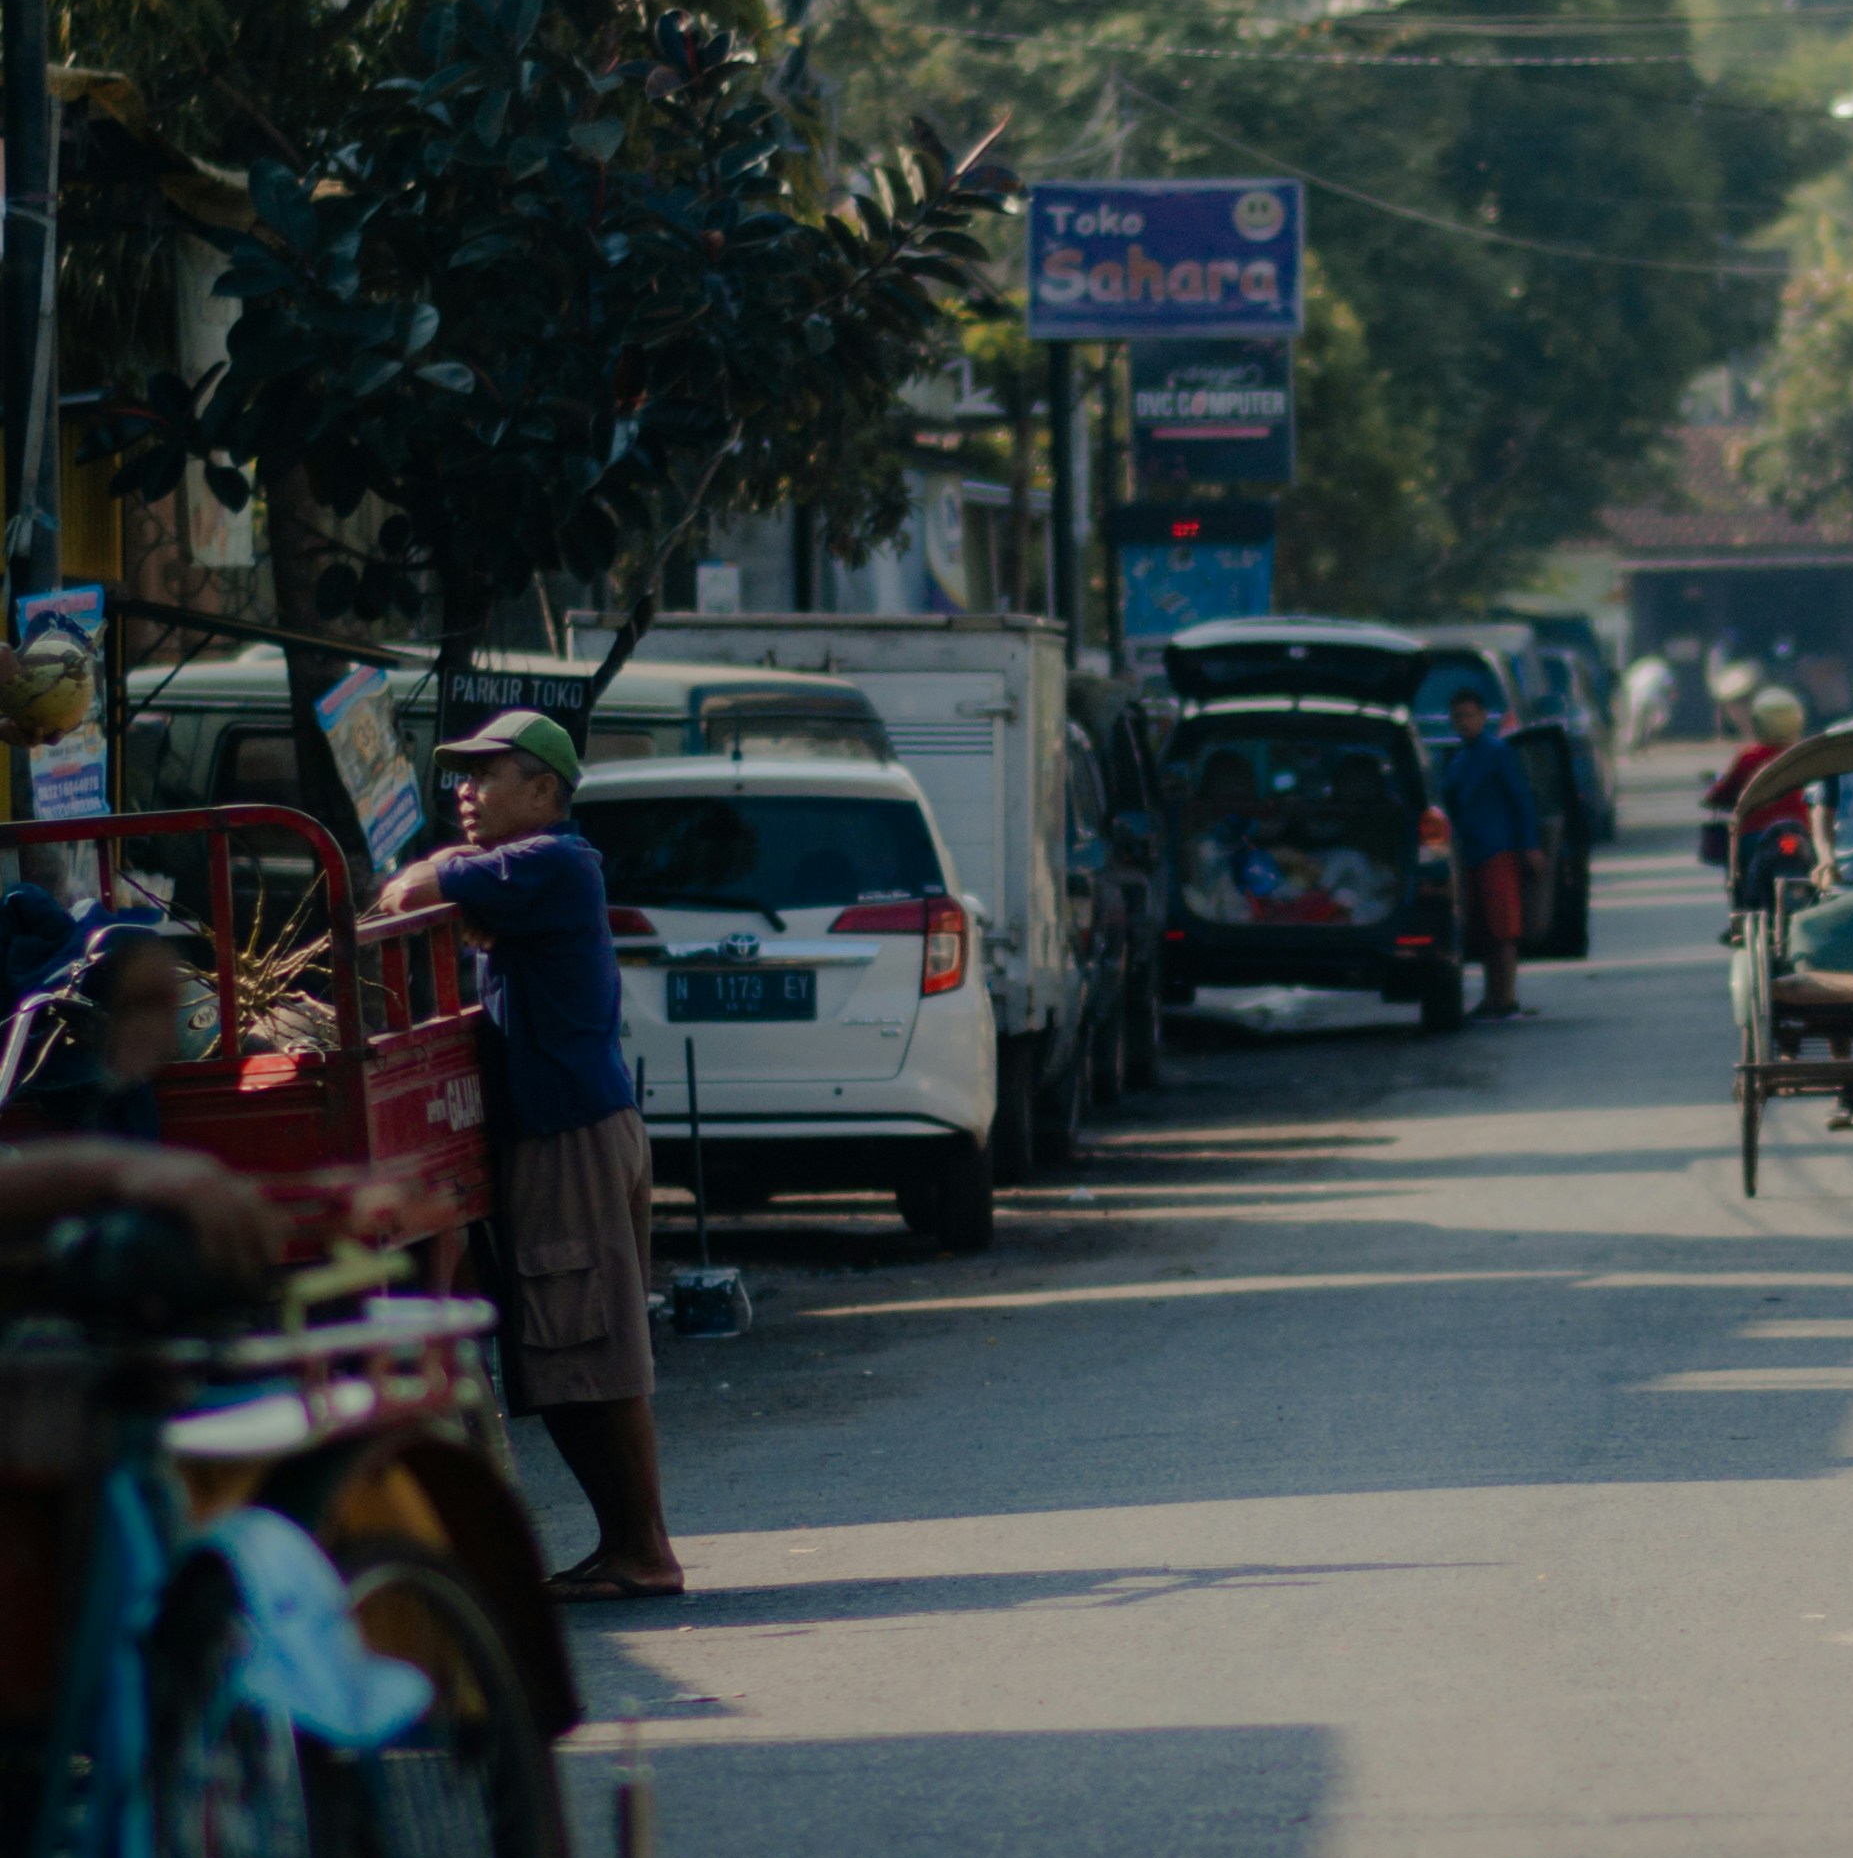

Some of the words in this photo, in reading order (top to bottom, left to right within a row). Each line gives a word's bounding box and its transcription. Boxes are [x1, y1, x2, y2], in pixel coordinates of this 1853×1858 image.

[1046, 204, 1146, 237] Toko
[1038, 244, 1281, 304] Sahara
[452, 675, 523, 706] PARKIR
[531, 680, 584, 709] TOKO
[675, 976, 689, 1000] N
[715, 975, 762, 1000] 1173
[784, 974, 809, 999] EY
